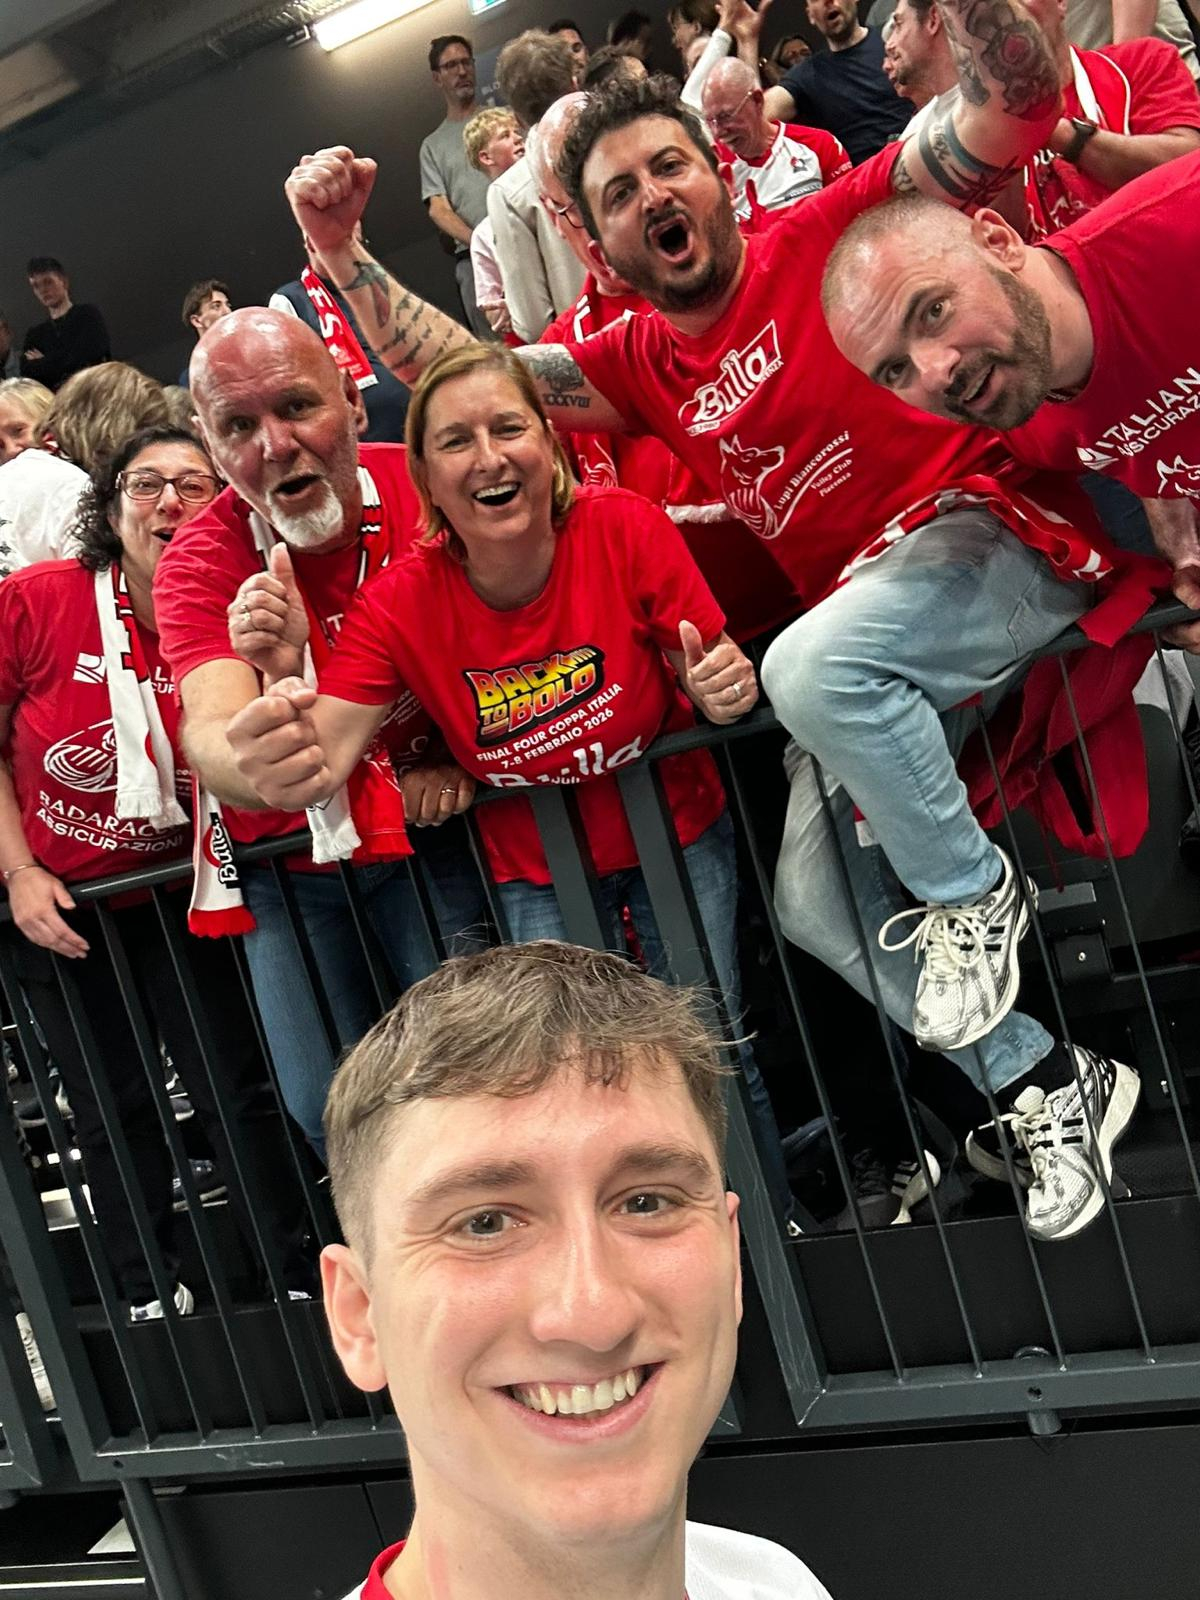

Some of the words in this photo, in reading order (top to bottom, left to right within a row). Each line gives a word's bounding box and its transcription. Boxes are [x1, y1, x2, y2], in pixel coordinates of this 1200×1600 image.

[692, 346, 768, 422] Bulla
[774, 485, 794, 511] Lupi
[790, 430, 850, 487] Biancorossi
[832, 458, 853, 474] Club
[466, 648, 596, 708] BACK
[479, 703, 508, 726] TO
[508, 663, 596, 732] BOLO
[476, 746, 513, 762] FINAL
[513, 731, 547, 750] FOUR
[548, 708, 588, 736] COPPA
[587, 683, 623, 713] ITALIA
[501, 756, 523, 769] 7-8
[524, 726, 583, 761] FEBBRAIO
[584, 707, 614, 731] 2026
